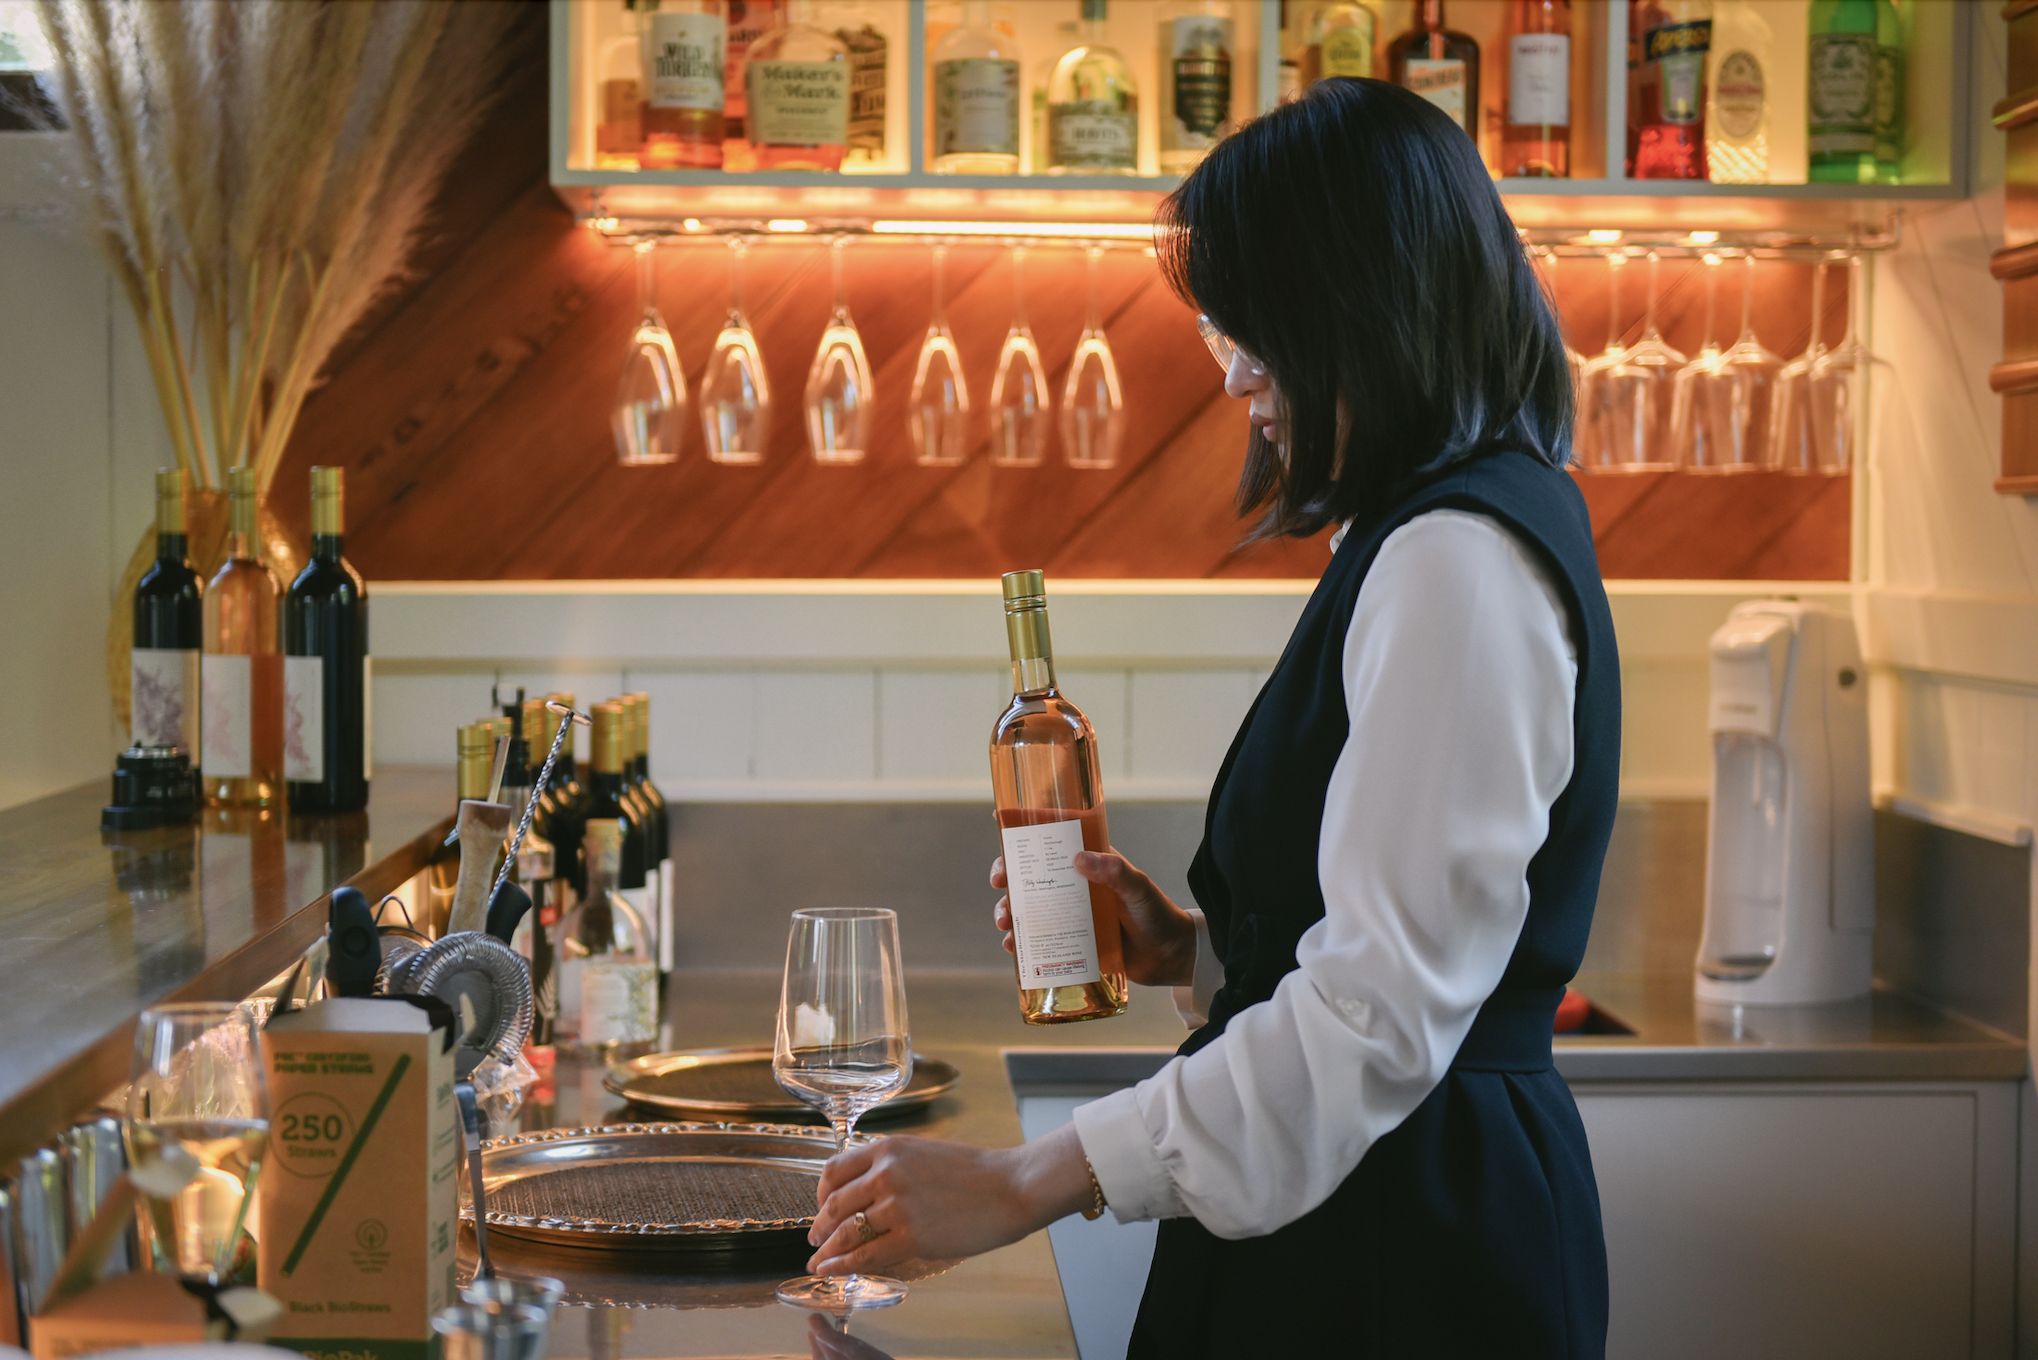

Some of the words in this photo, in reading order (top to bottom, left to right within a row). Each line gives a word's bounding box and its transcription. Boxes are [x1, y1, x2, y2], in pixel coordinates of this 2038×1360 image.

[663, 42, 705, 60] WILD
[762, 65, 844, 82] Maker's
[282, 1114, 342, 1142] 250
[287, 1144, 337, 1158] Straws
[289, 1301, 323, 1312] Black
